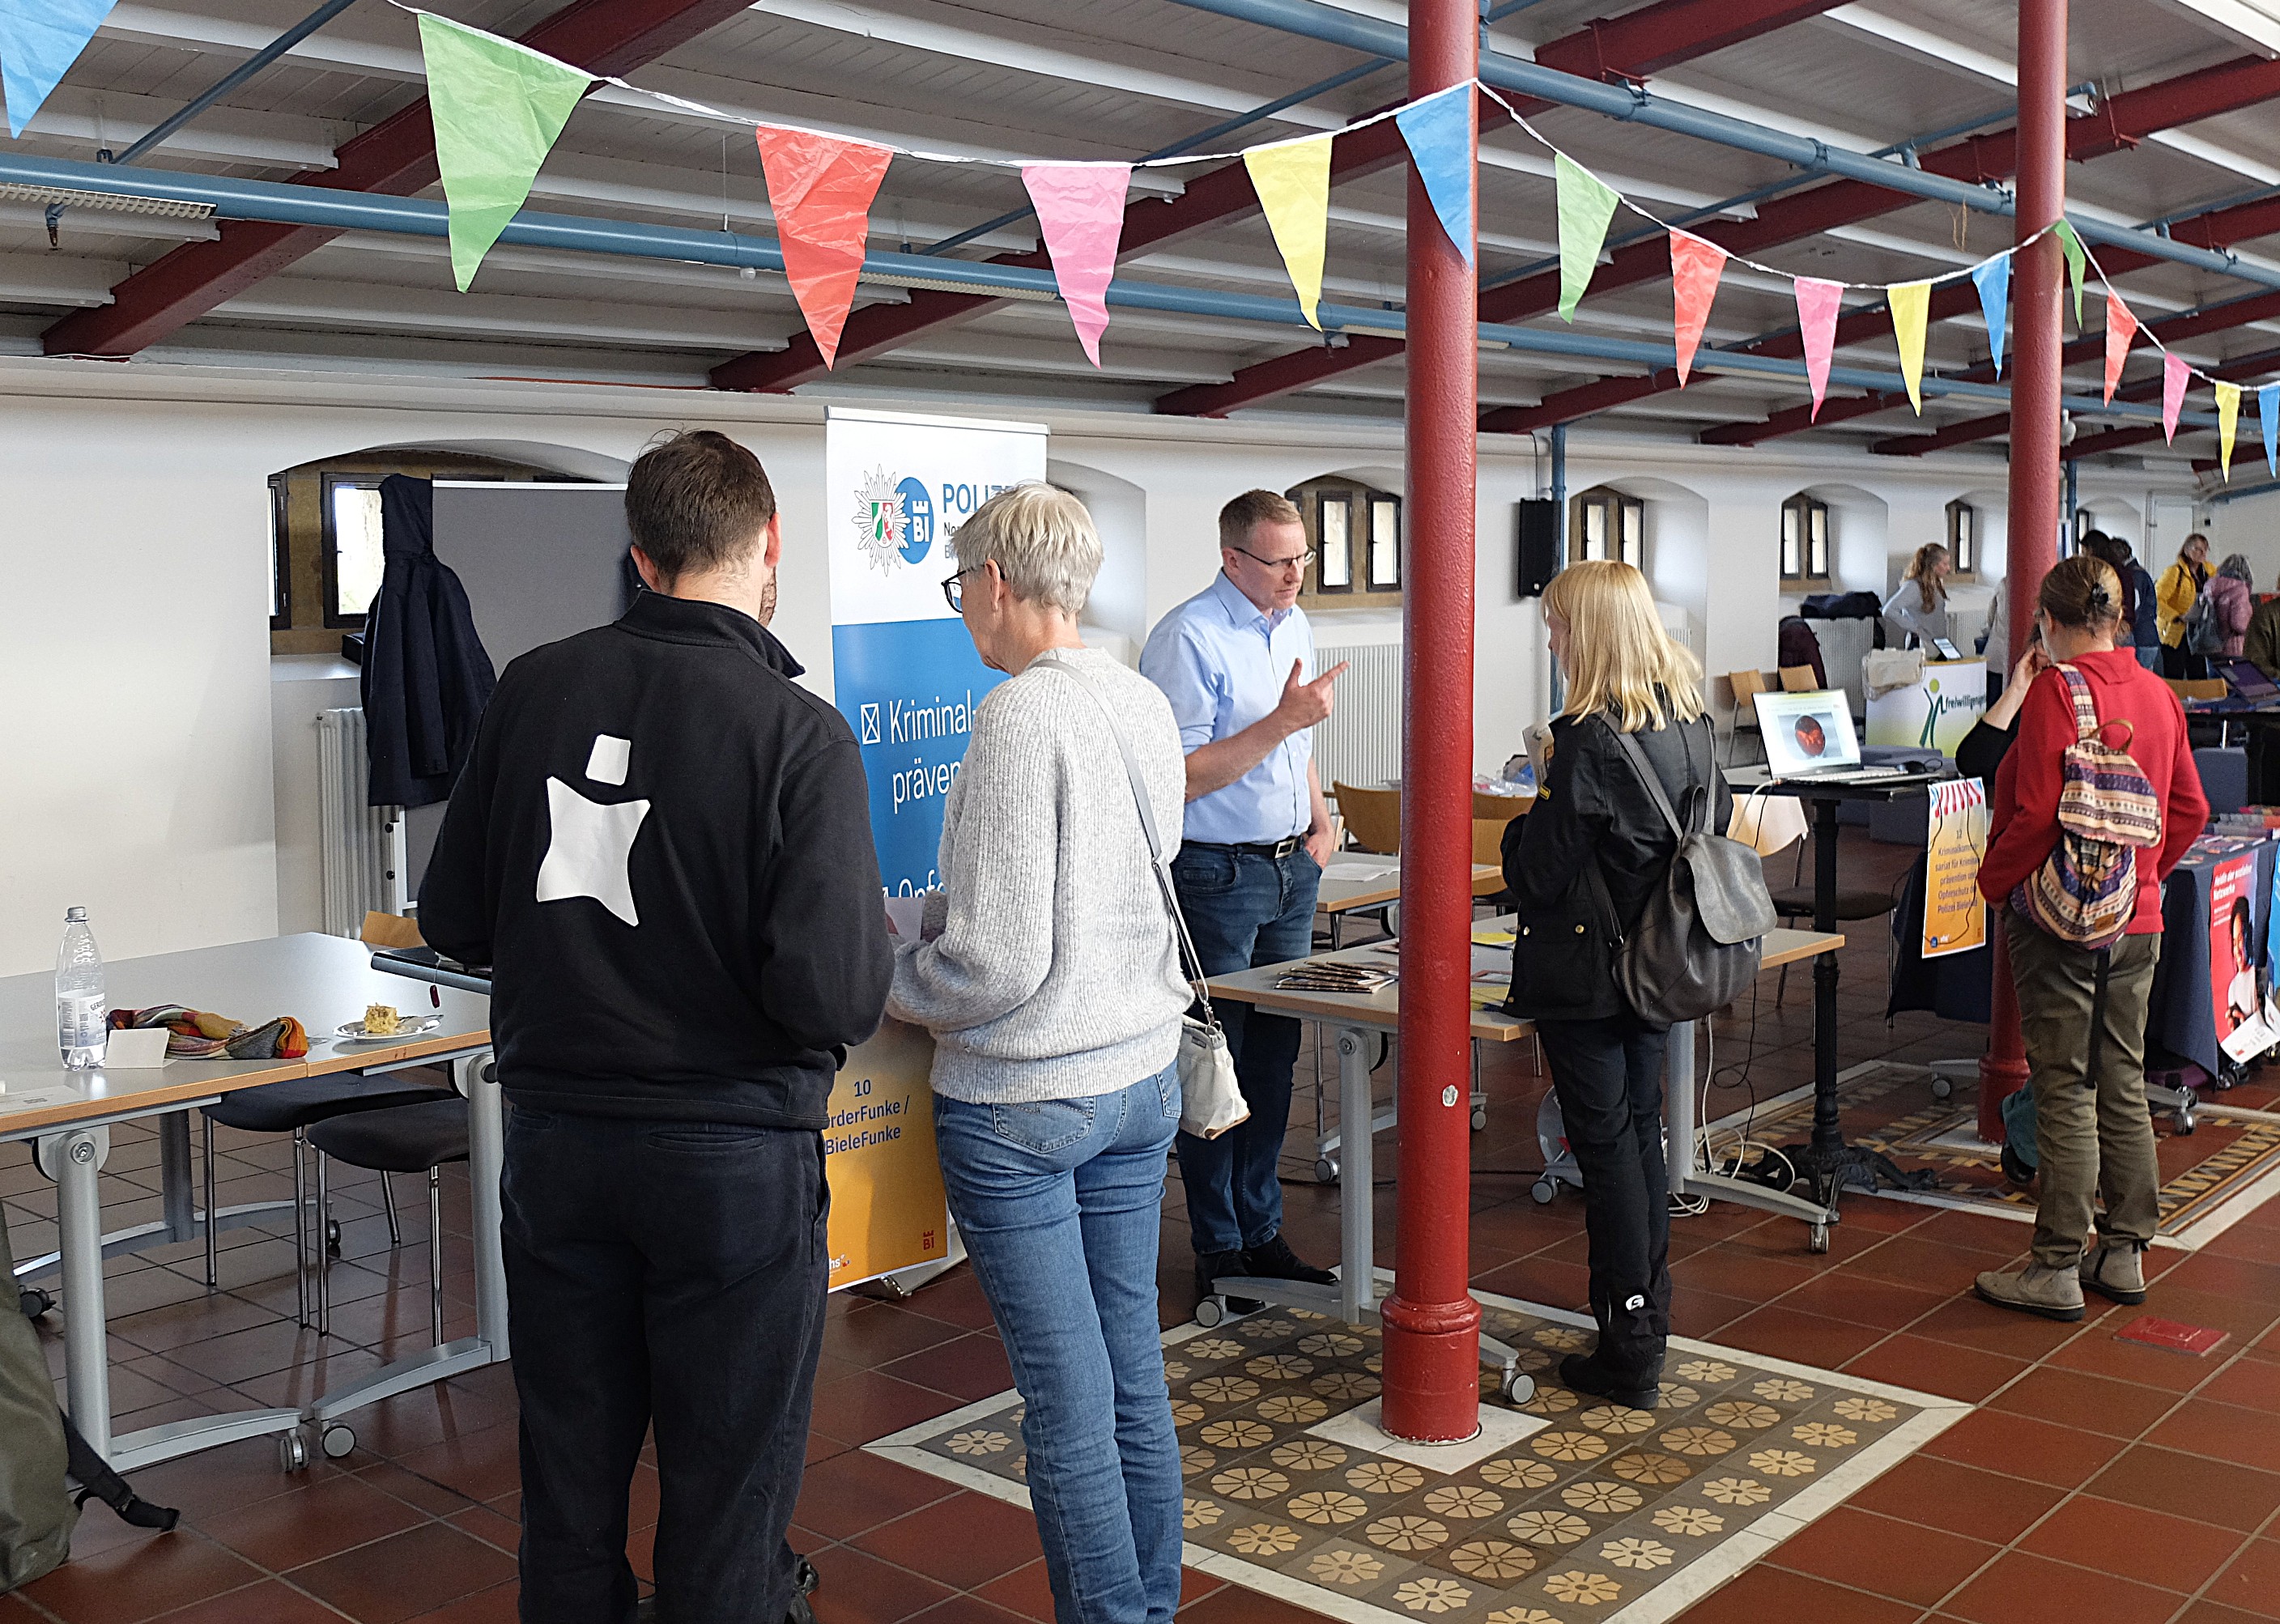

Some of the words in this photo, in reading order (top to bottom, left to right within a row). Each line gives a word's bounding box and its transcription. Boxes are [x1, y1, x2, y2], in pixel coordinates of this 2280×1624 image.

[942, 483, 1015, 514] POLI
[892, 757, 963, 814] präven
[854, 1079, 871, 1097] 10
[829, 1099, 900, 1128] rderFunke
[904, 1095, 910, 1115] /
[826, 1124, 900, 1155] BieleFunke
[829, 1258, 840, 1270] hs
